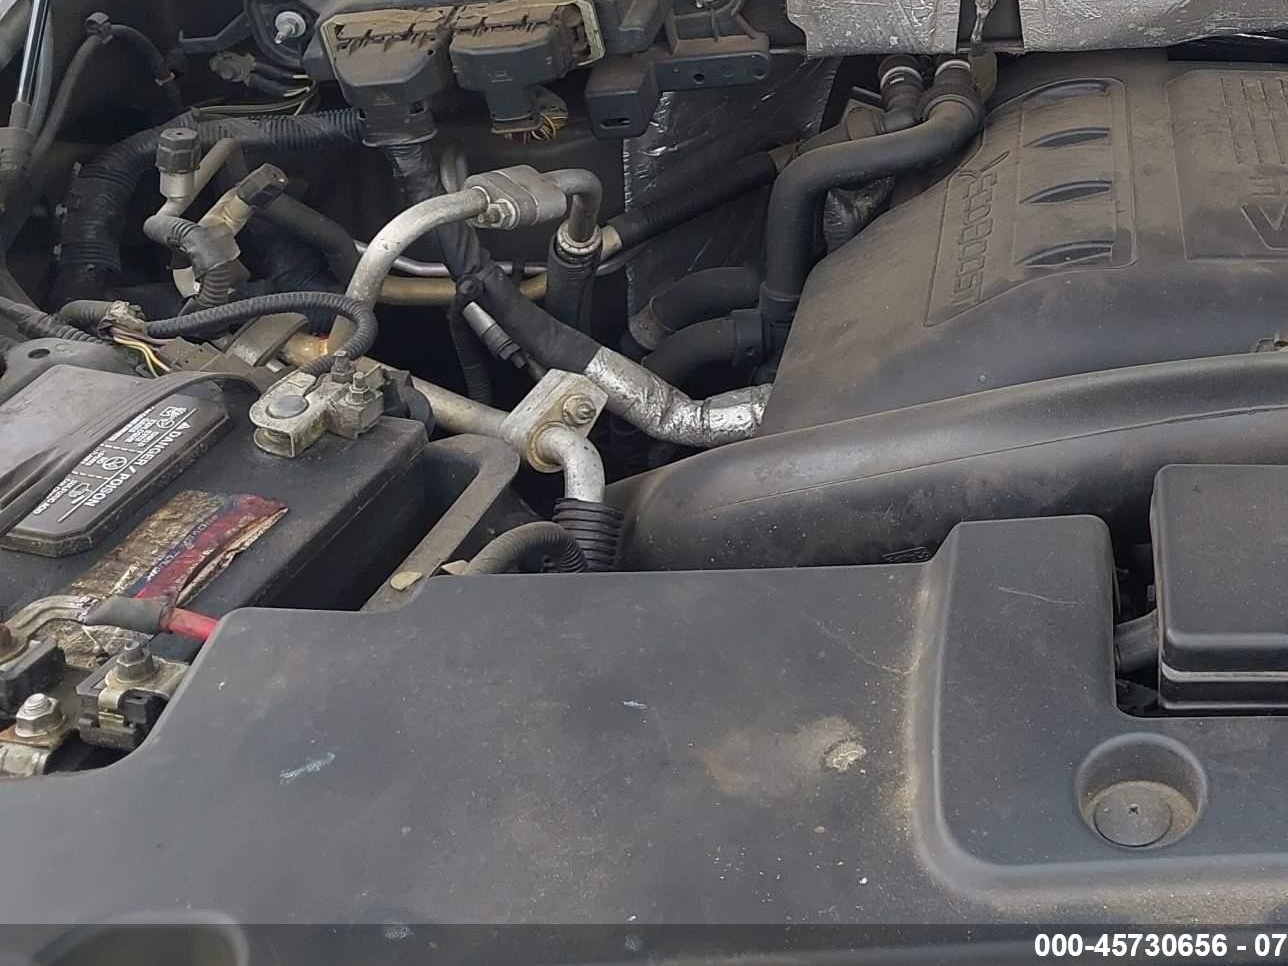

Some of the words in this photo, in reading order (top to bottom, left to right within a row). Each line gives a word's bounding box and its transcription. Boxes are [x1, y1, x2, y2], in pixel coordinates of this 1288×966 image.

[133, 430, 182, 466] DANGER
[86, 472, 131, 507] POISON
[33, 503, 50, 515] ACID
